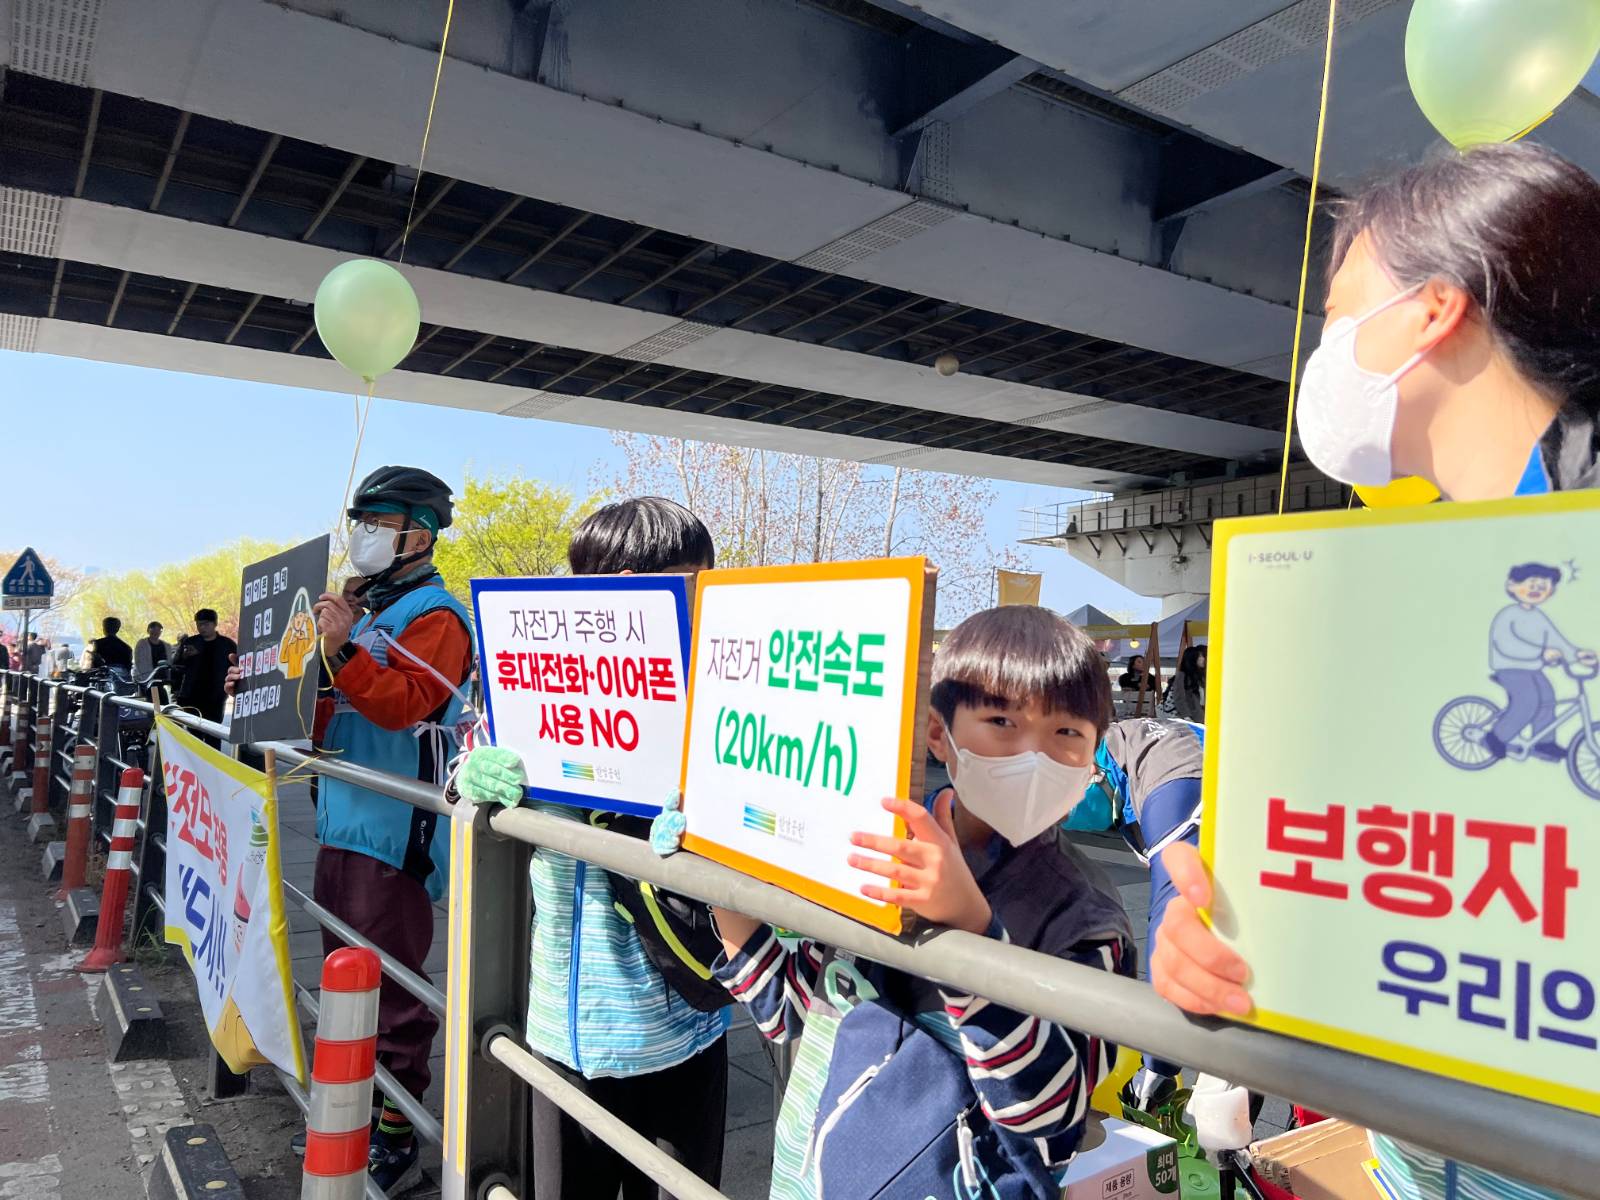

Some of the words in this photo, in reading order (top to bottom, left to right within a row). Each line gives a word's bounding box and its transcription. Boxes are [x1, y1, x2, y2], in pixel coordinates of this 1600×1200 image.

[509, 609, 568, 642] 자전거
[574, 609, 617, 643] 주행
[626, 610, 645, 645] 시
[707, 637, 762, 684] 자전거
[768, 629, 886, 697] 안전속도
[539, 703, 585, 746] 사용
[589, 708, 640, 751] NO
[715, 706, 858, 796] (20km/h)
[1260, 798, 1579, 940] 보행자
[1155, 1165, 1177, 1187] 50개
[1157, 1152, 1174, 1168] 최대
